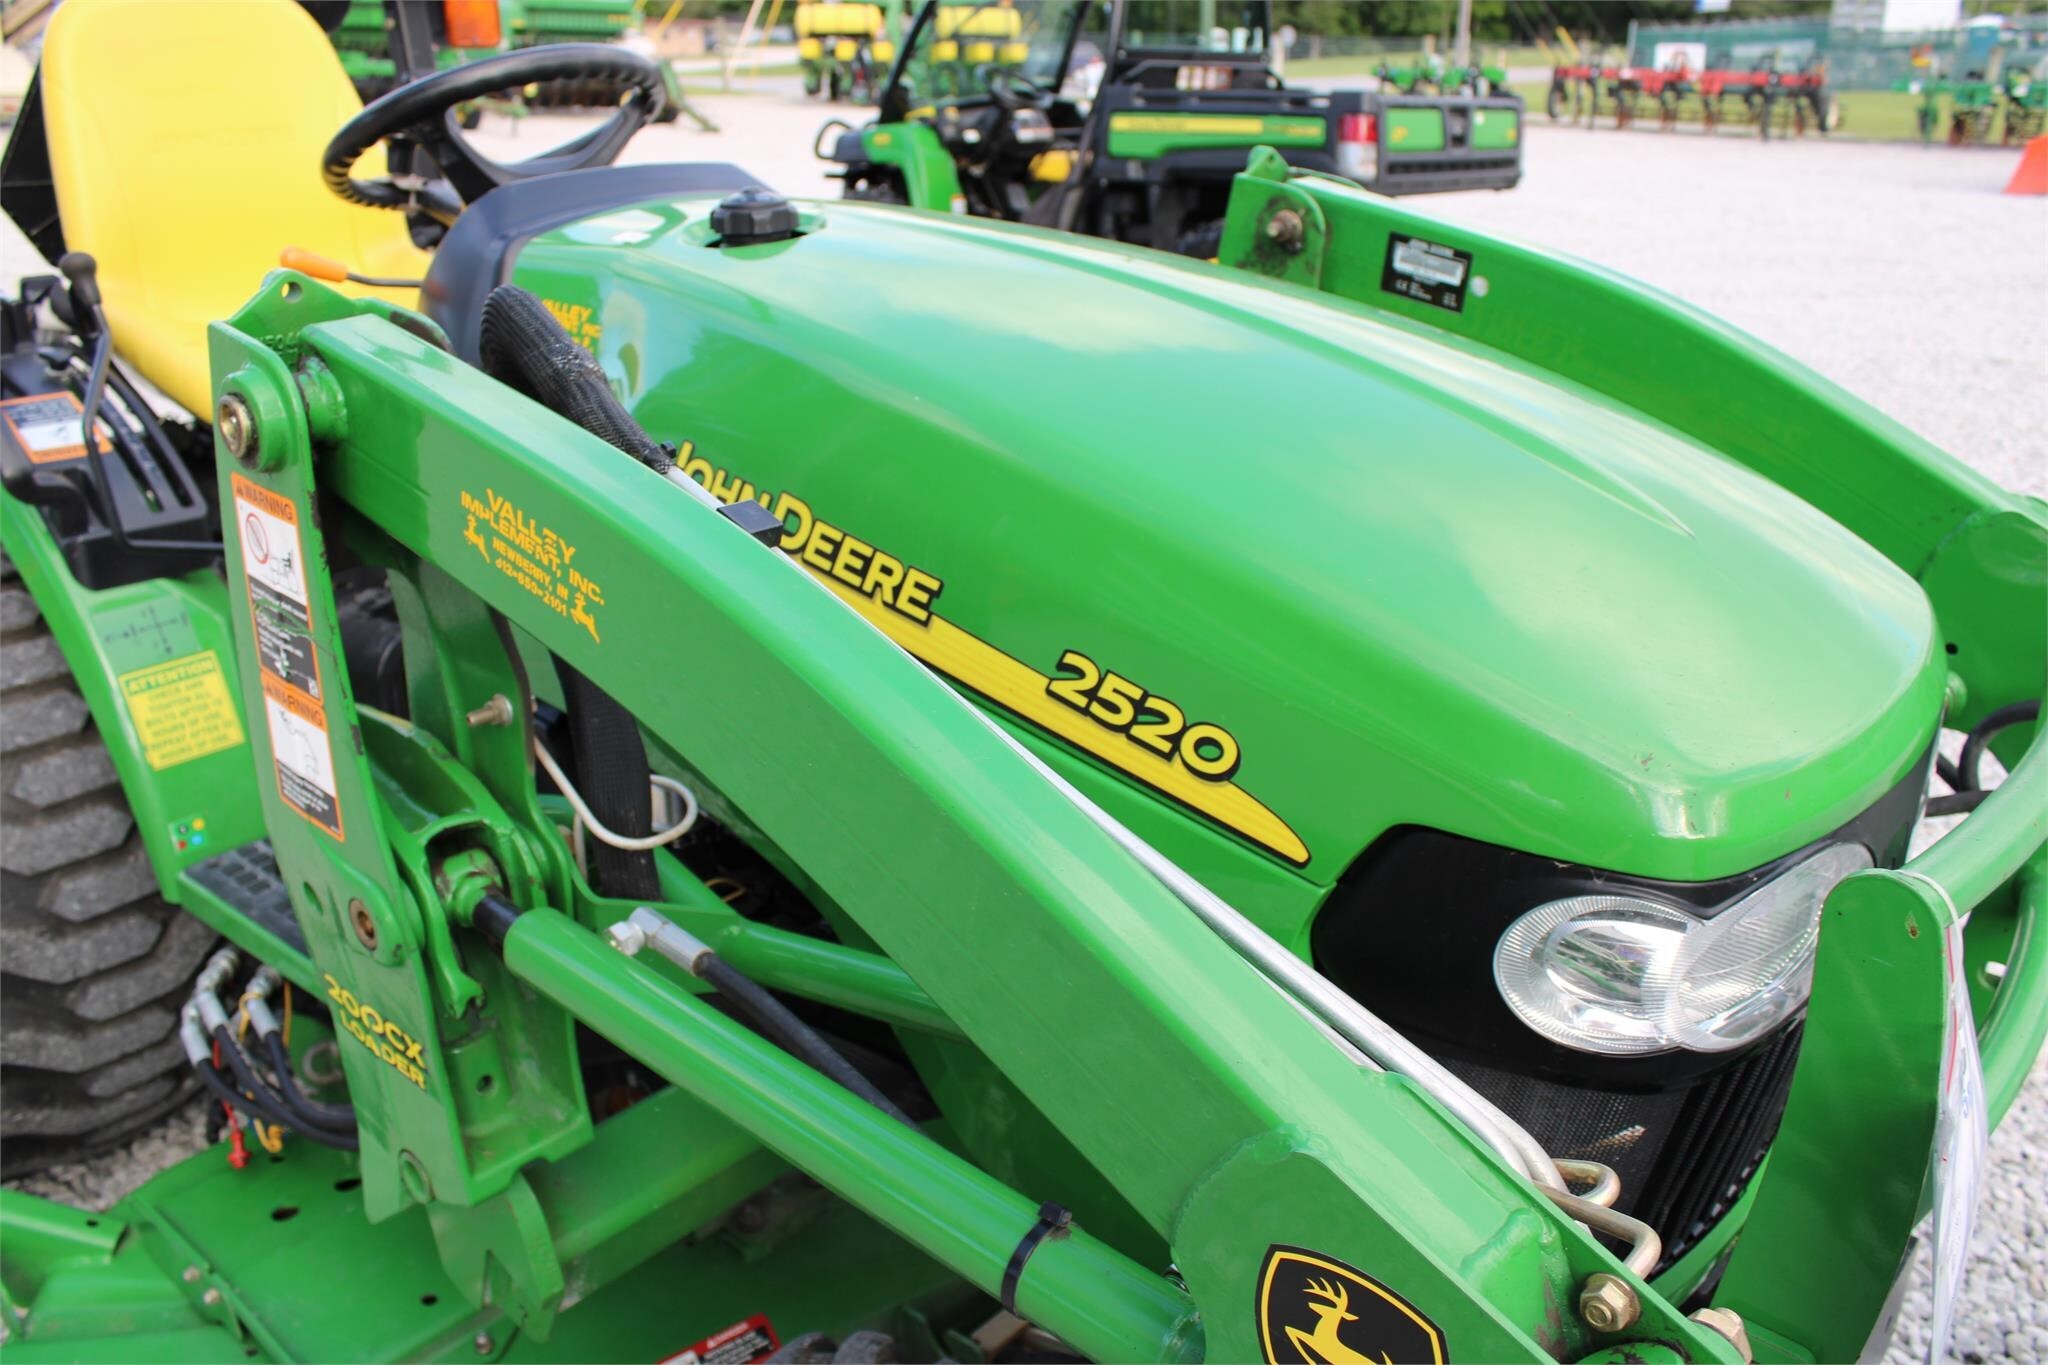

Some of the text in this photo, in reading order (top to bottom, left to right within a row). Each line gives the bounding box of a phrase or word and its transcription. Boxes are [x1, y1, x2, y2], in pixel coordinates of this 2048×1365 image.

[242, 486, 294, 521] WARNING
[486, 488, 577, 566] VALLEY
[568, 567, 606, 606] INC.
[772, 489, 943, 626] DEERE
[556, 582, 570, 601] IN
[128, 660, 215, 693] ATTENTION
[272, 685, 324, 727] WARNING
[1047, 650, 1240, 780] 2520
[323, 972, 427, 1070] 200CX
[338, 1008, 426, 1089] LOADER
